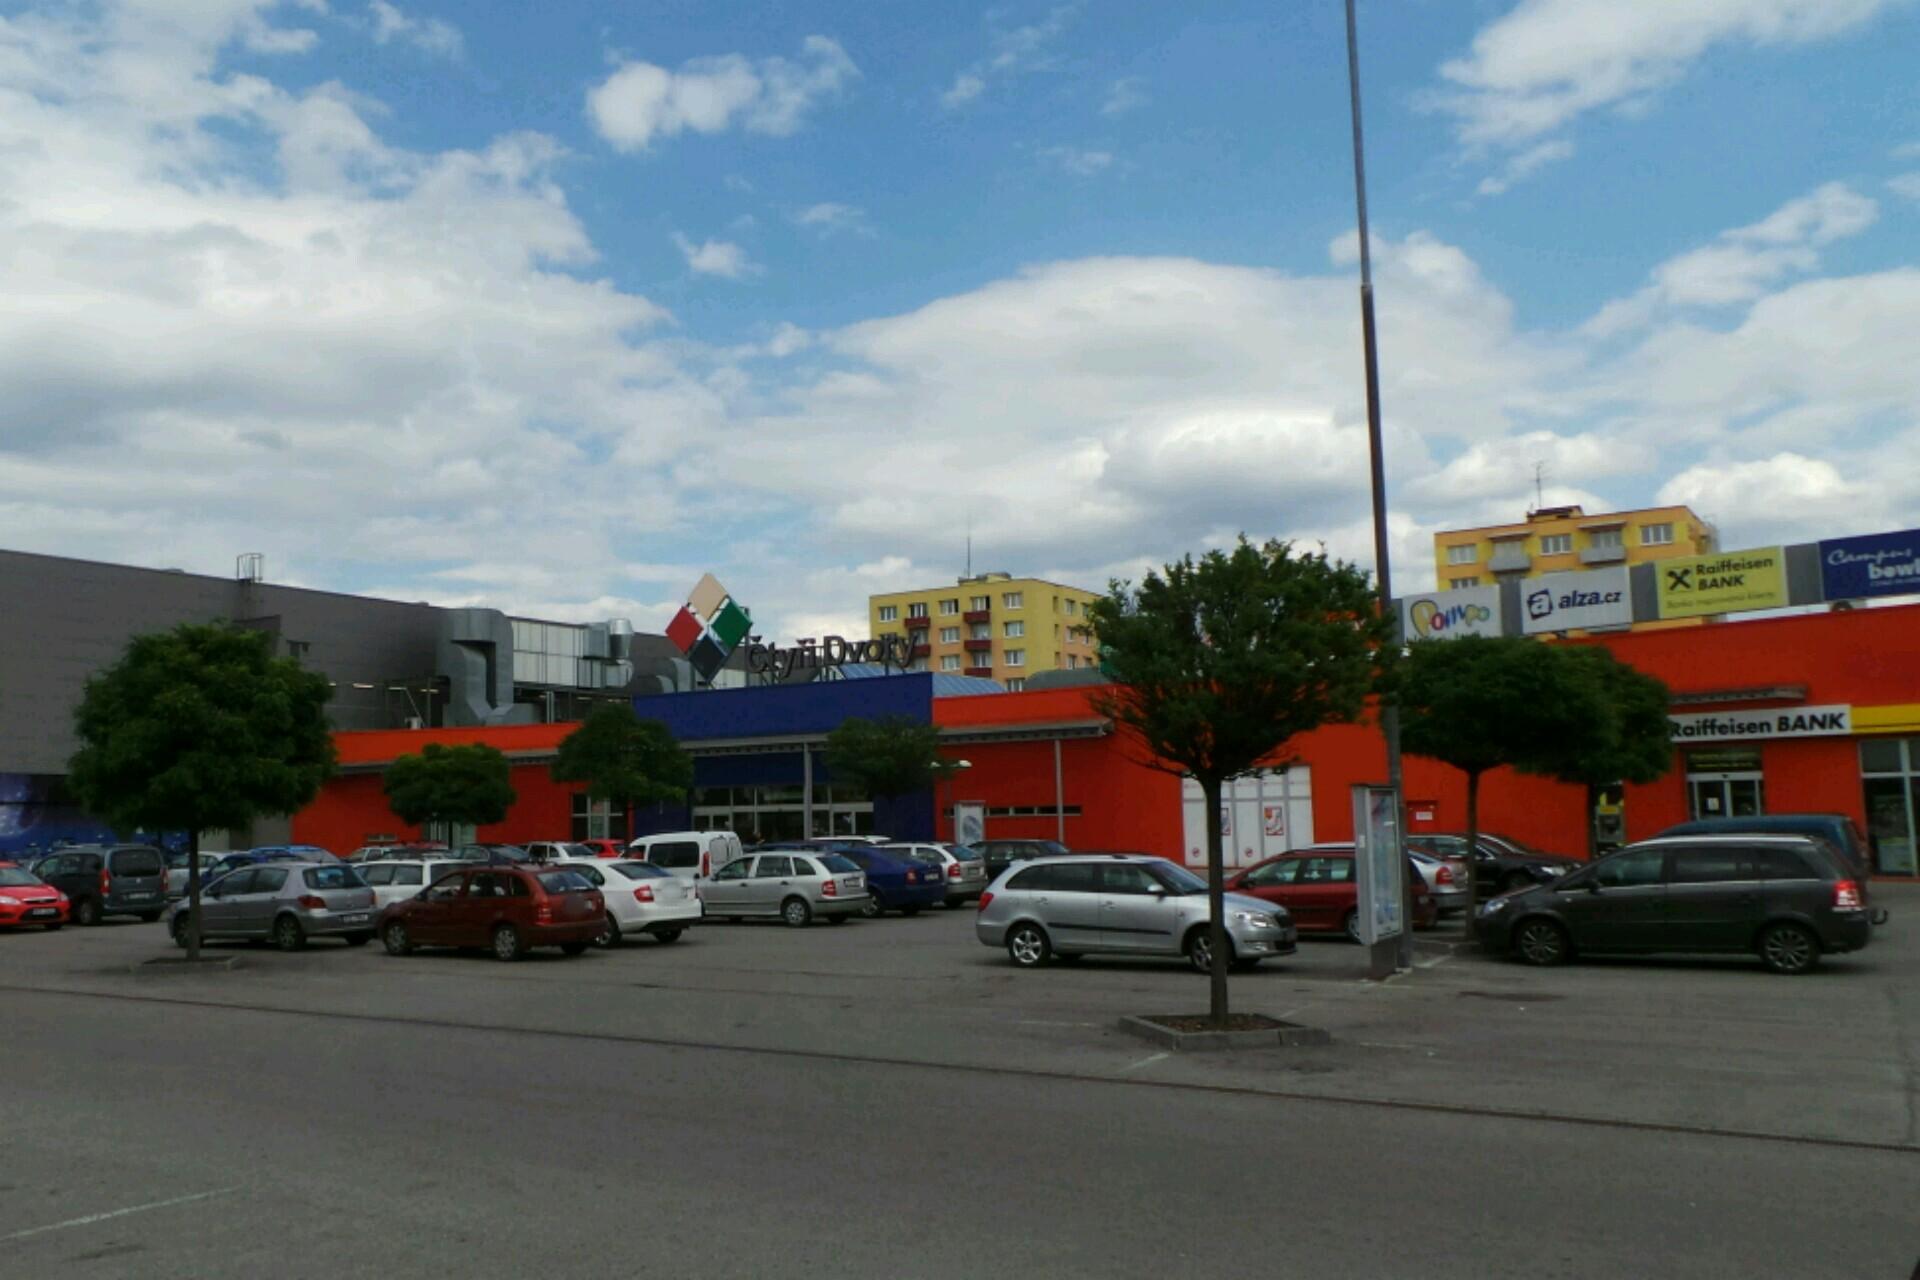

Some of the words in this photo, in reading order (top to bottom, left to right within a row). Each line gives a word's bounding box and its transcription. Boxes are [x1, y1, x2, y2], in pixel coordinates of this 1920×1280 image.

[1695, 557, 1774, 576] Raiffeisen
[1697, 574, 1745, 591] BANK
[1558, 590, 1623, 609] alza.cz
[824, 633, 918, 668] Dvory
[1671, 717, 1772, 738] Raiffeisen
[1777, 712, 1846, 732] BANK
